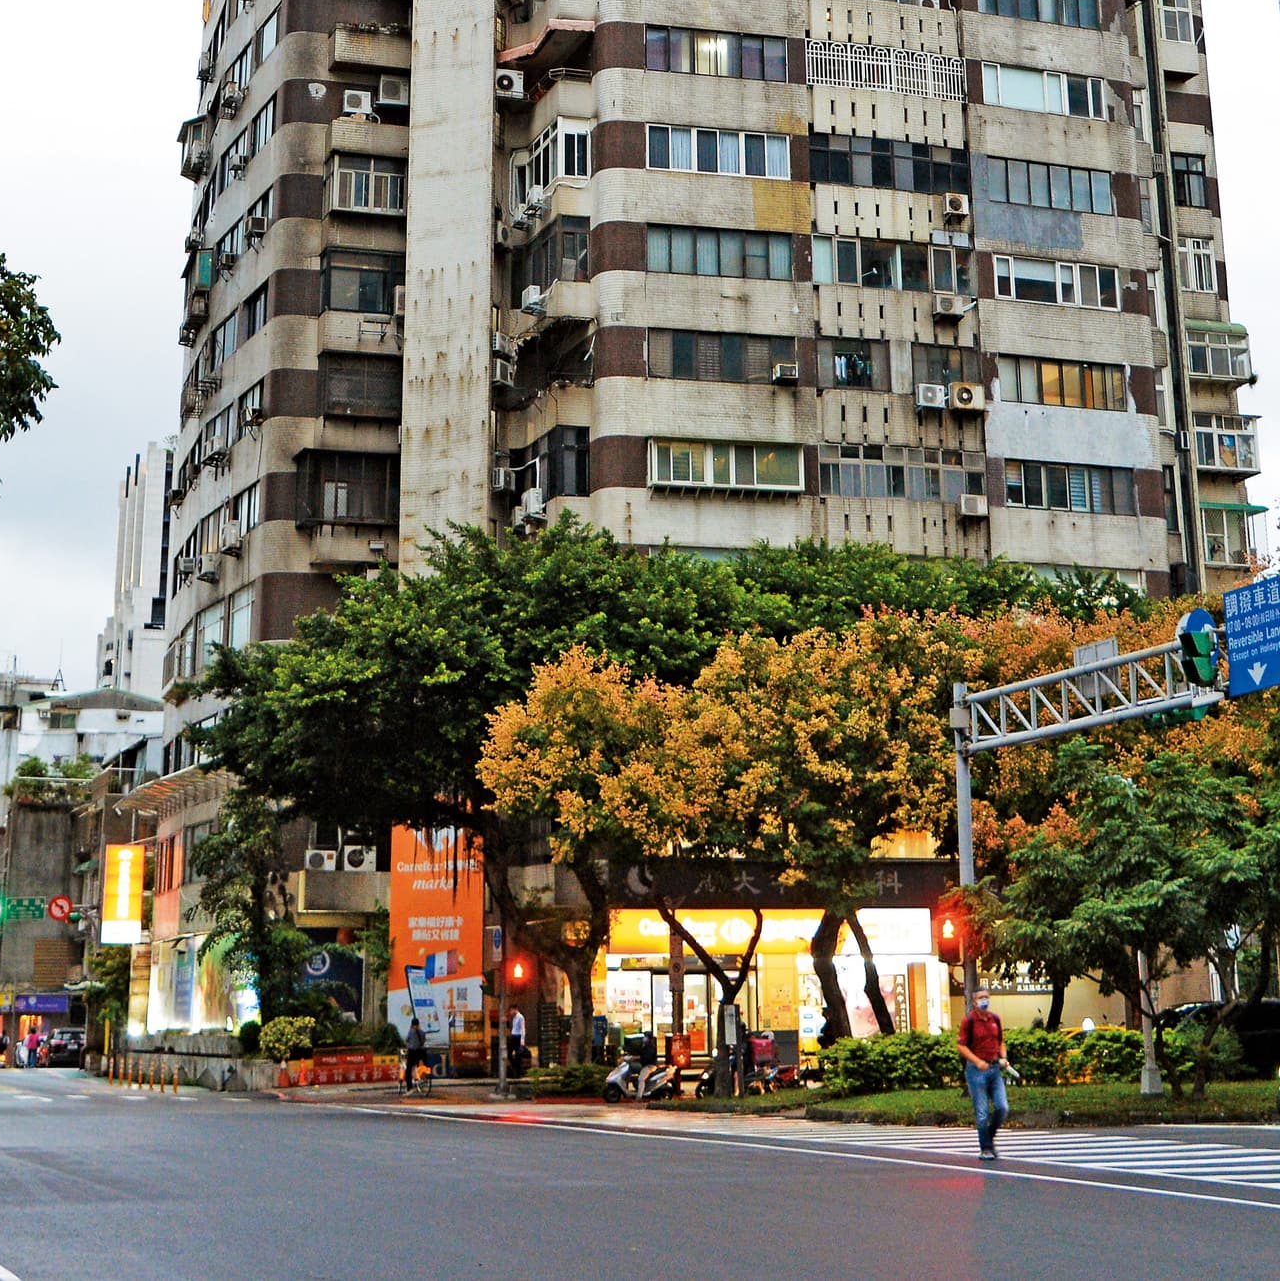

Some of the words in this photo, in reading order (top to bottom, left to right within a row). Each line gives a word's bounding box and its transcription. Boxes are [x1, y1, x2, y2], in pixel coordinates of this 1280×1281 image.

[1225, 580, 1280, 618] 調撥車道
[1228, 629, 1264, 650] Reversible
[1251, 647, 1258, 656] on
